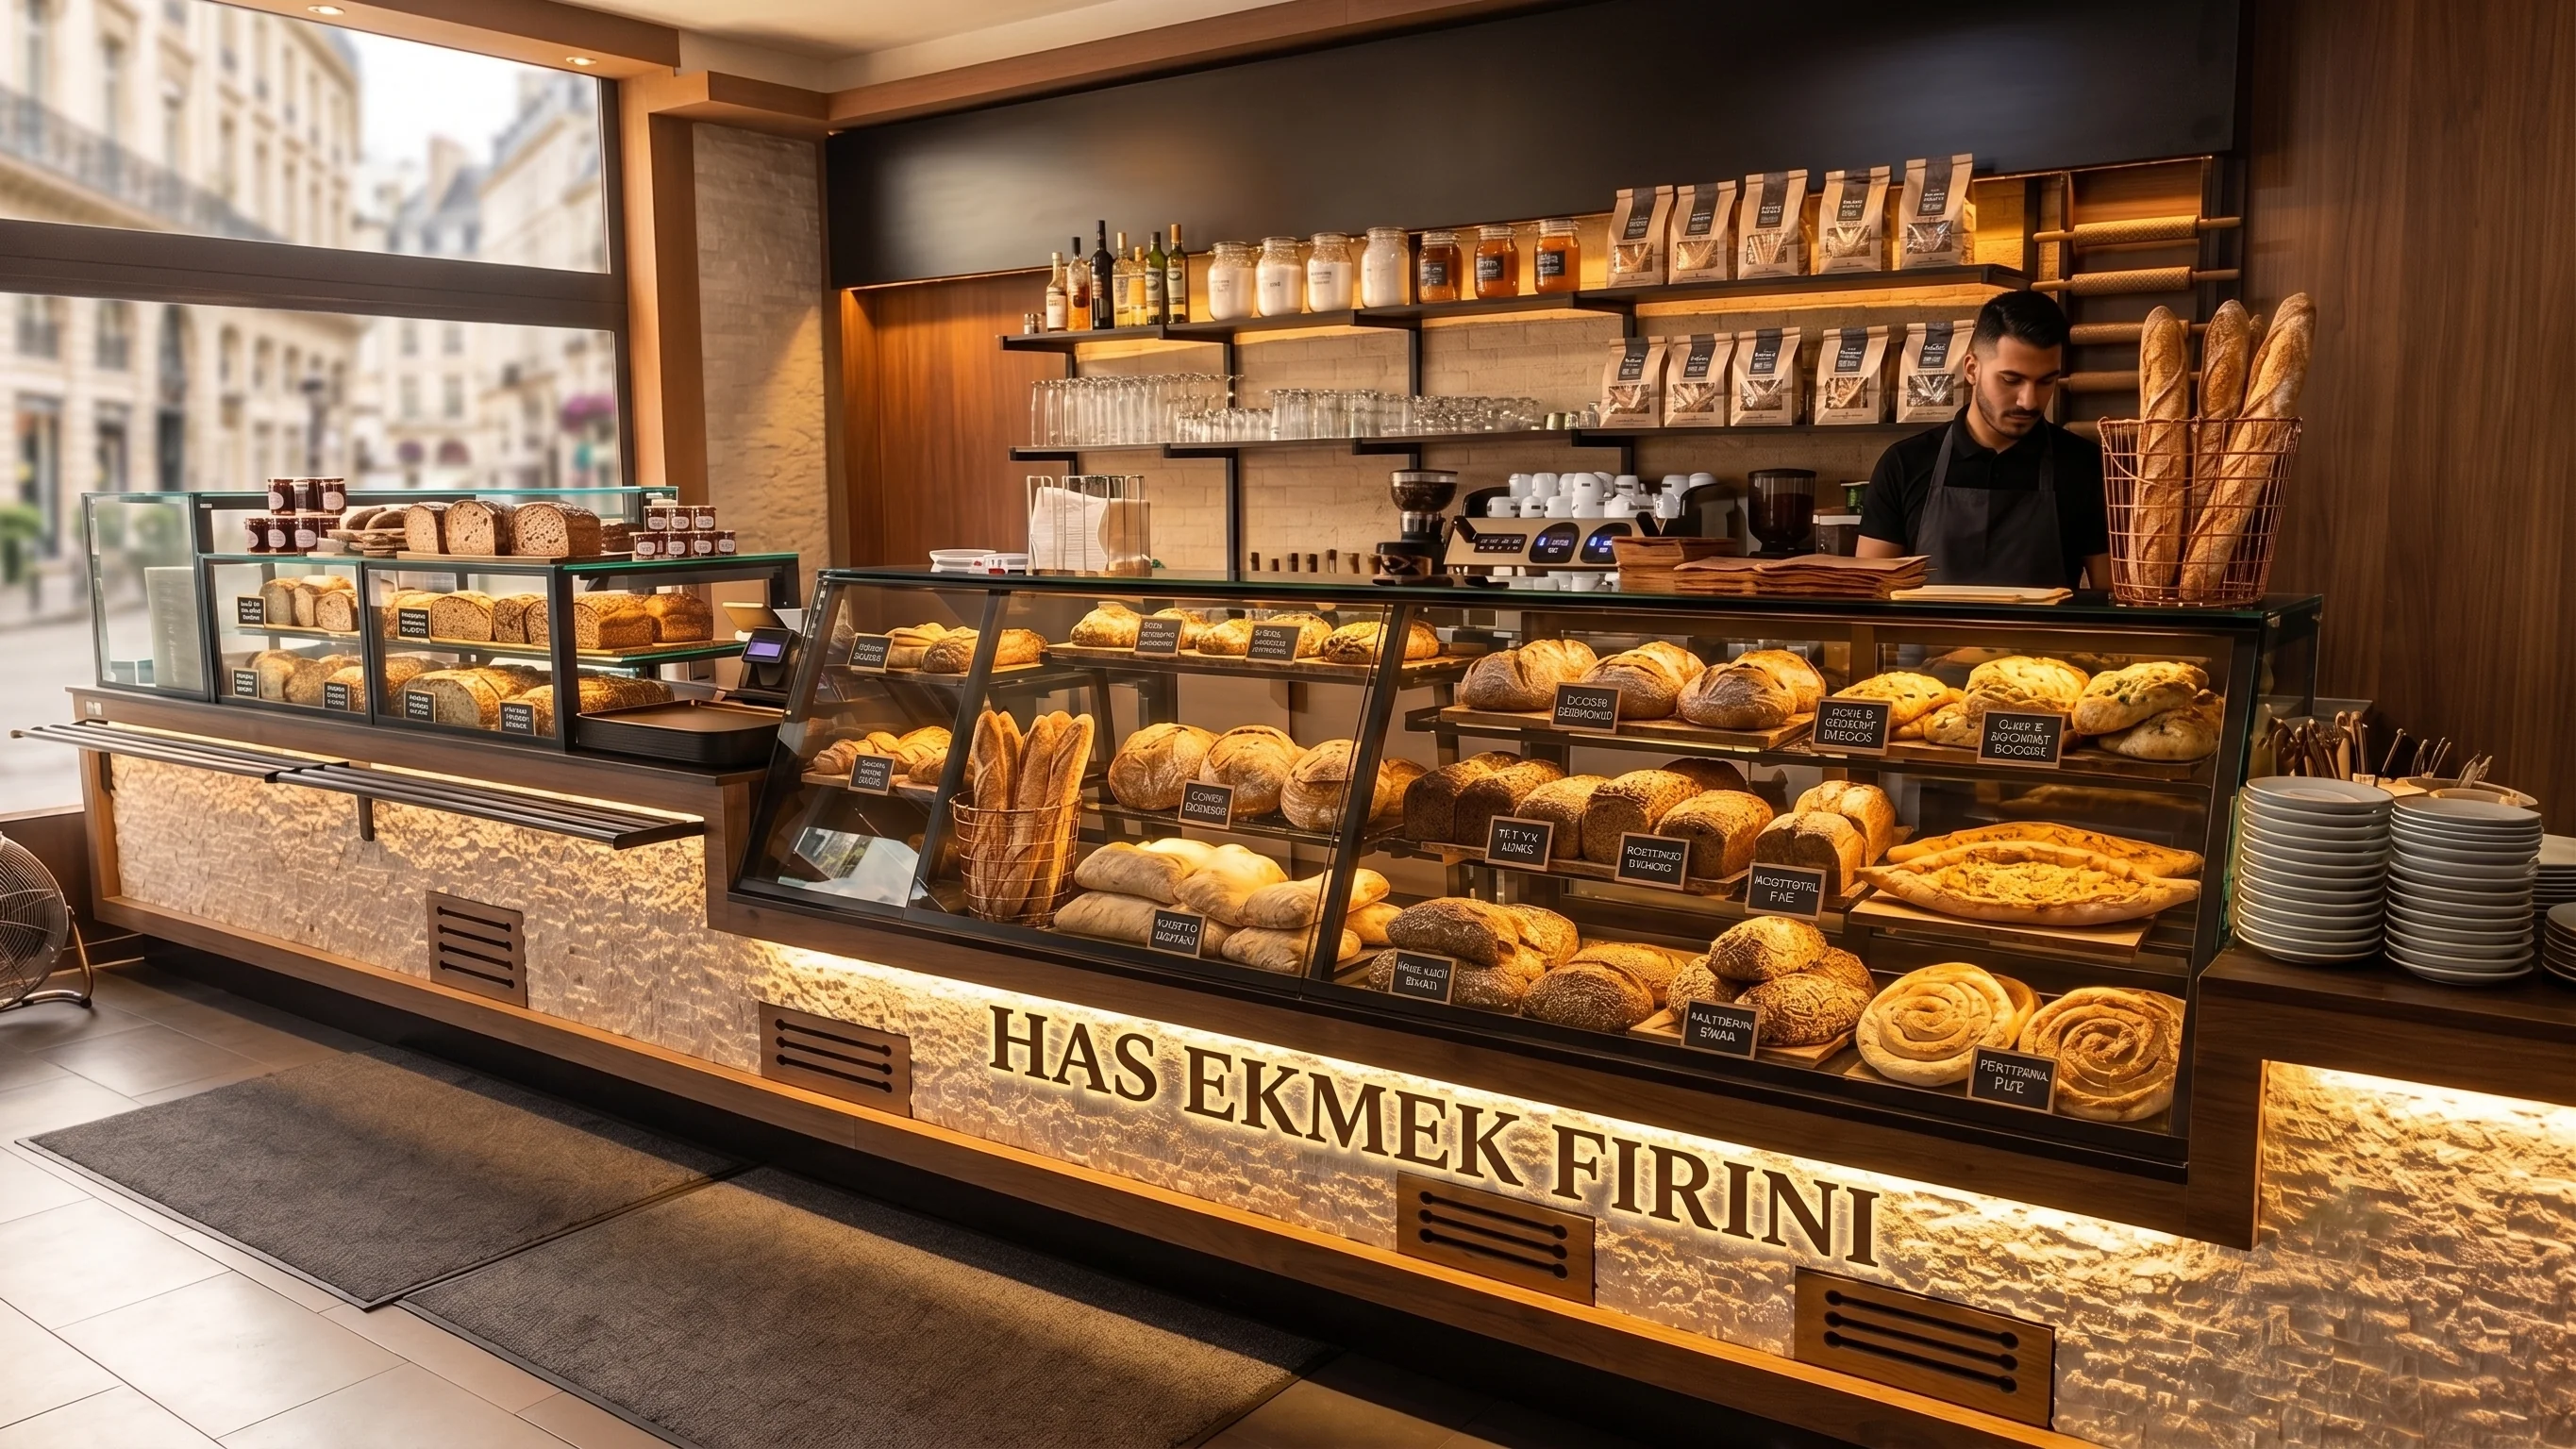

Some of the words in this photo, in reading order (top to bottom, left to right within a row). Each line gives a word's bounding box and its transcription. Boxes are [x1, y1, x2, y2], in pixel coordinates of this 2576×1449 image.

[1769, 891, 1795, 903] FAE
[988, 1005, 1158, 1103] HAS
[1183, 1044, 1524, 1188] EKMEK
[1550, 1124, 1881, 1268] FIRINI
